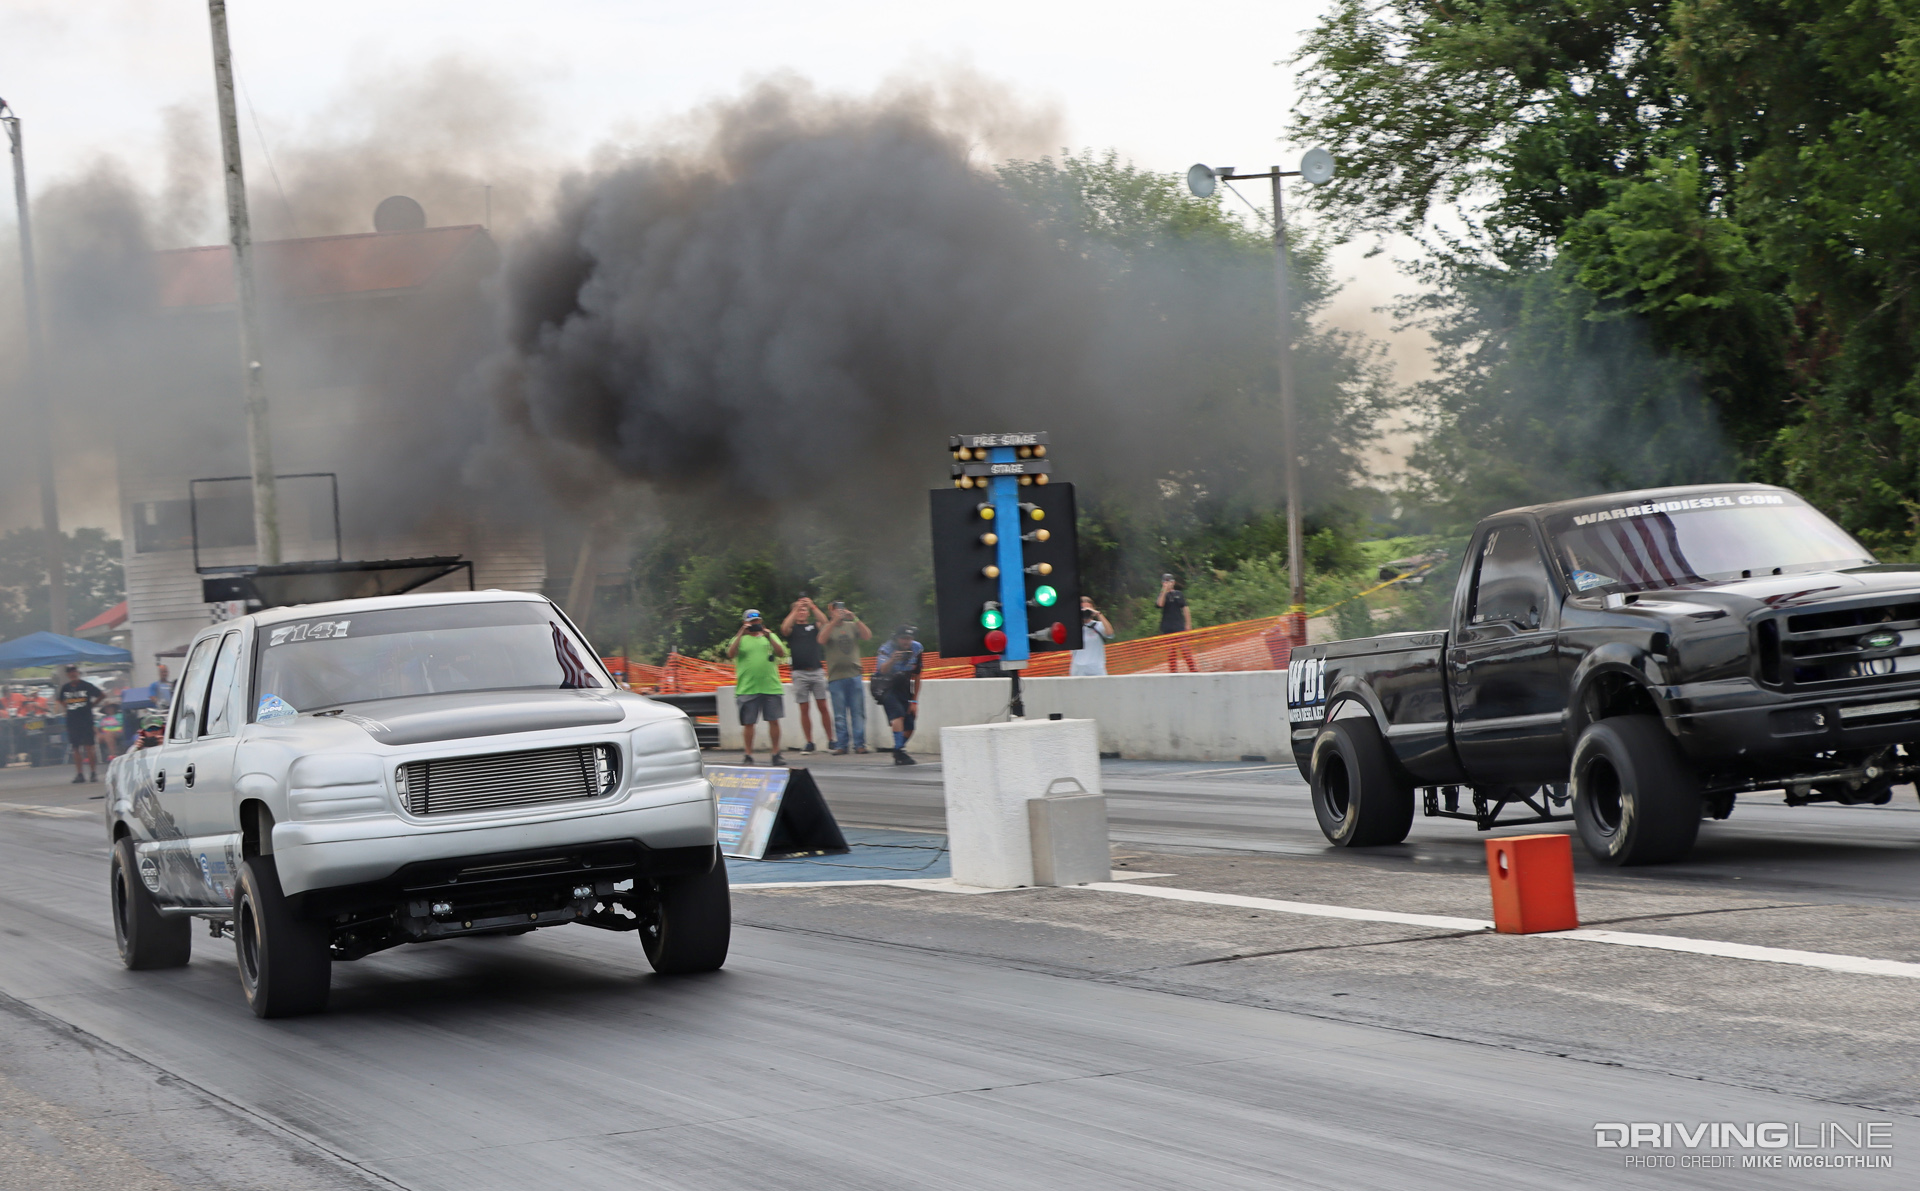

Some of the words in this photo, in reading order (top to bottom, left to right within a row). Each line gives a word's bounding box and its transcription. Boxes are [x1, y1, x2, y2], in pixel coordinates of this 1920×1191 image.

[991, 464, 1024, 474] STAGE
[270, 621, 351, 646] 7141
[260, 705, 283, 715] AirDog
